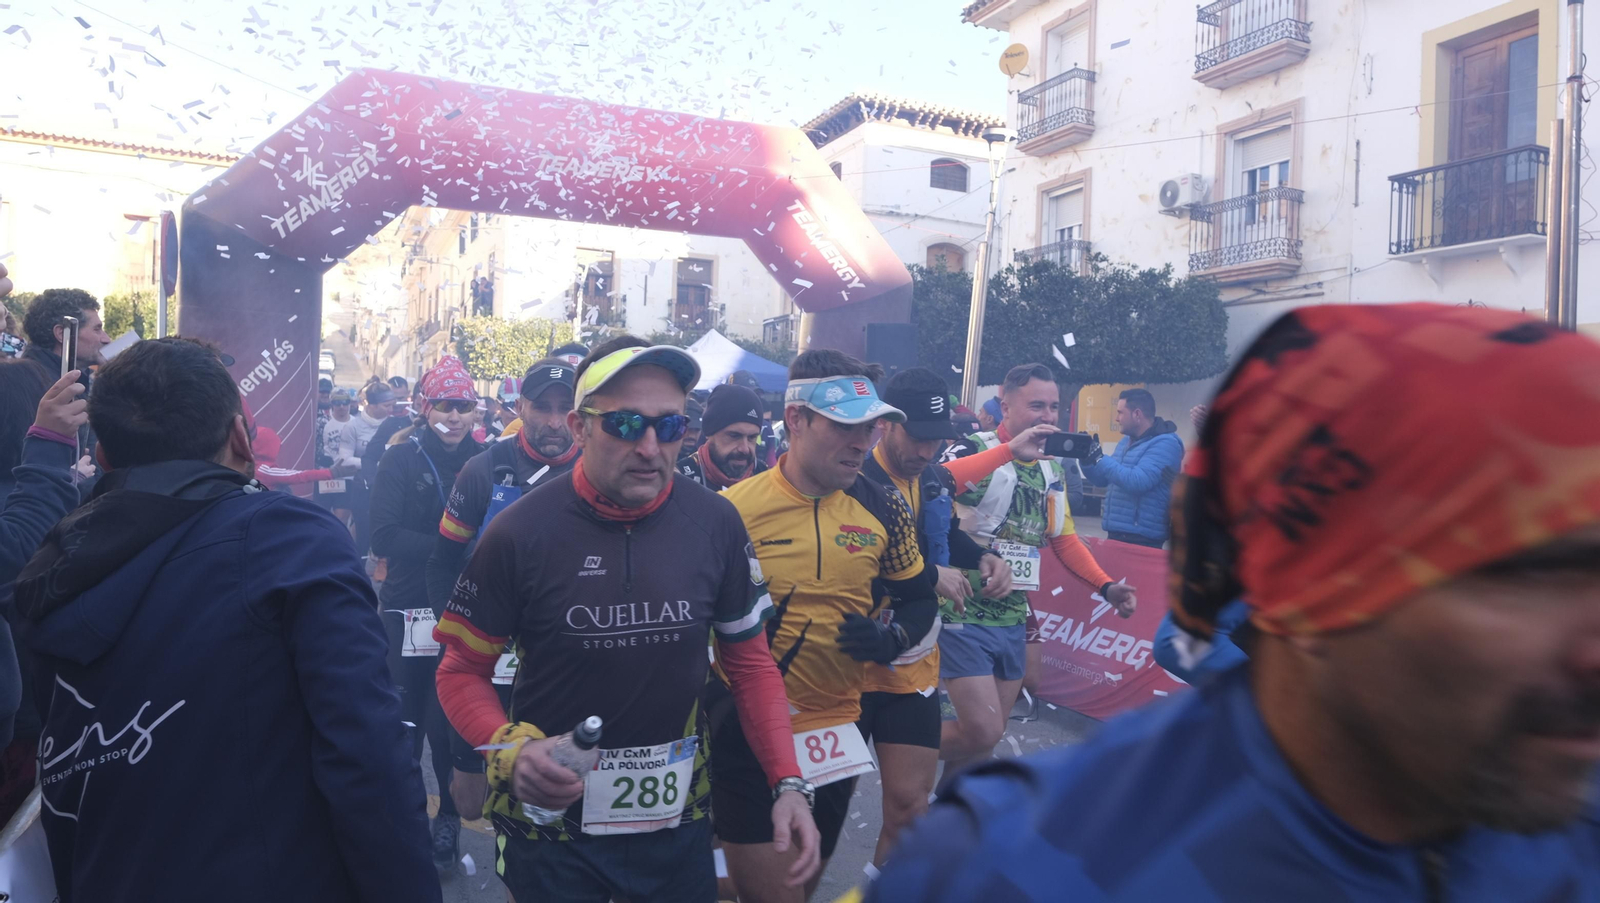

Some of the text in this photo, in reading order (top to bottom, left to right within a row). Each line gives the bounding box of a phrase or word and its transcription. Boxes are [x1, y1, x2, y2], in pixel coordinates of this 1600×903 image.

[270, 146, 379, 239] TEAMERGY
[786, 199, 866, 289] TEAMERGY
[566, 600, 694, 629] CUELLAR
[583, 633, 681, 649] STONE 1958
[75, 758, 95, 772] NON
[100, 747, 129, 764] STOP
[606, 750, 619, 758] IV
[623, 748, 651, 759] CxM
[804, 730, 846, 764] 82
[600, 762, 615, 771] LA
[610, 770, 678, 809] 288
